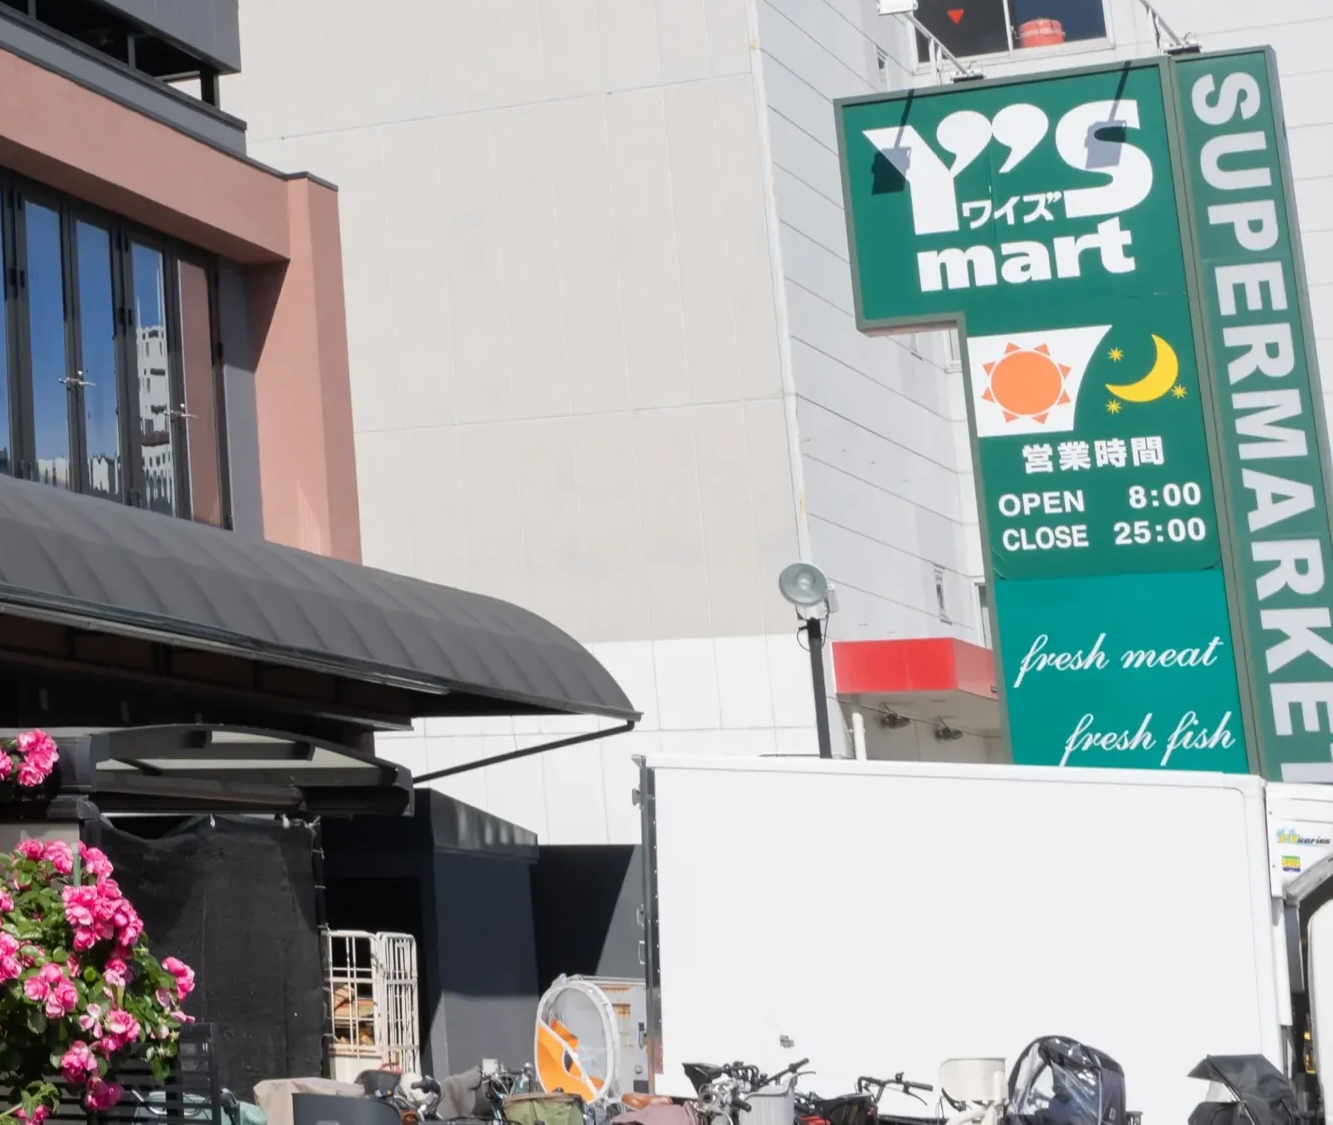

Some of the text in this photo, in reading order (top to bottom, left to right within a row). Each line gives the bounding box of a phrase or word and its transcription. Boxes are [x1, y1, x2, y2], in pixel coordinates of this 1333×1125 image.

[961, 190, 1063, 230] ワイズ
[916, 216, 1136, 292] mart
[1021, 435, 1165, 475] 営業時間
[998, 482, 1202, 517] OPEN 8:00
[1002, 517, 1207, 552] CLOSE 25:00
[1013, 632, 1224, 688] fresh meat
[1058, 710, 1236, 767] fresh fish
